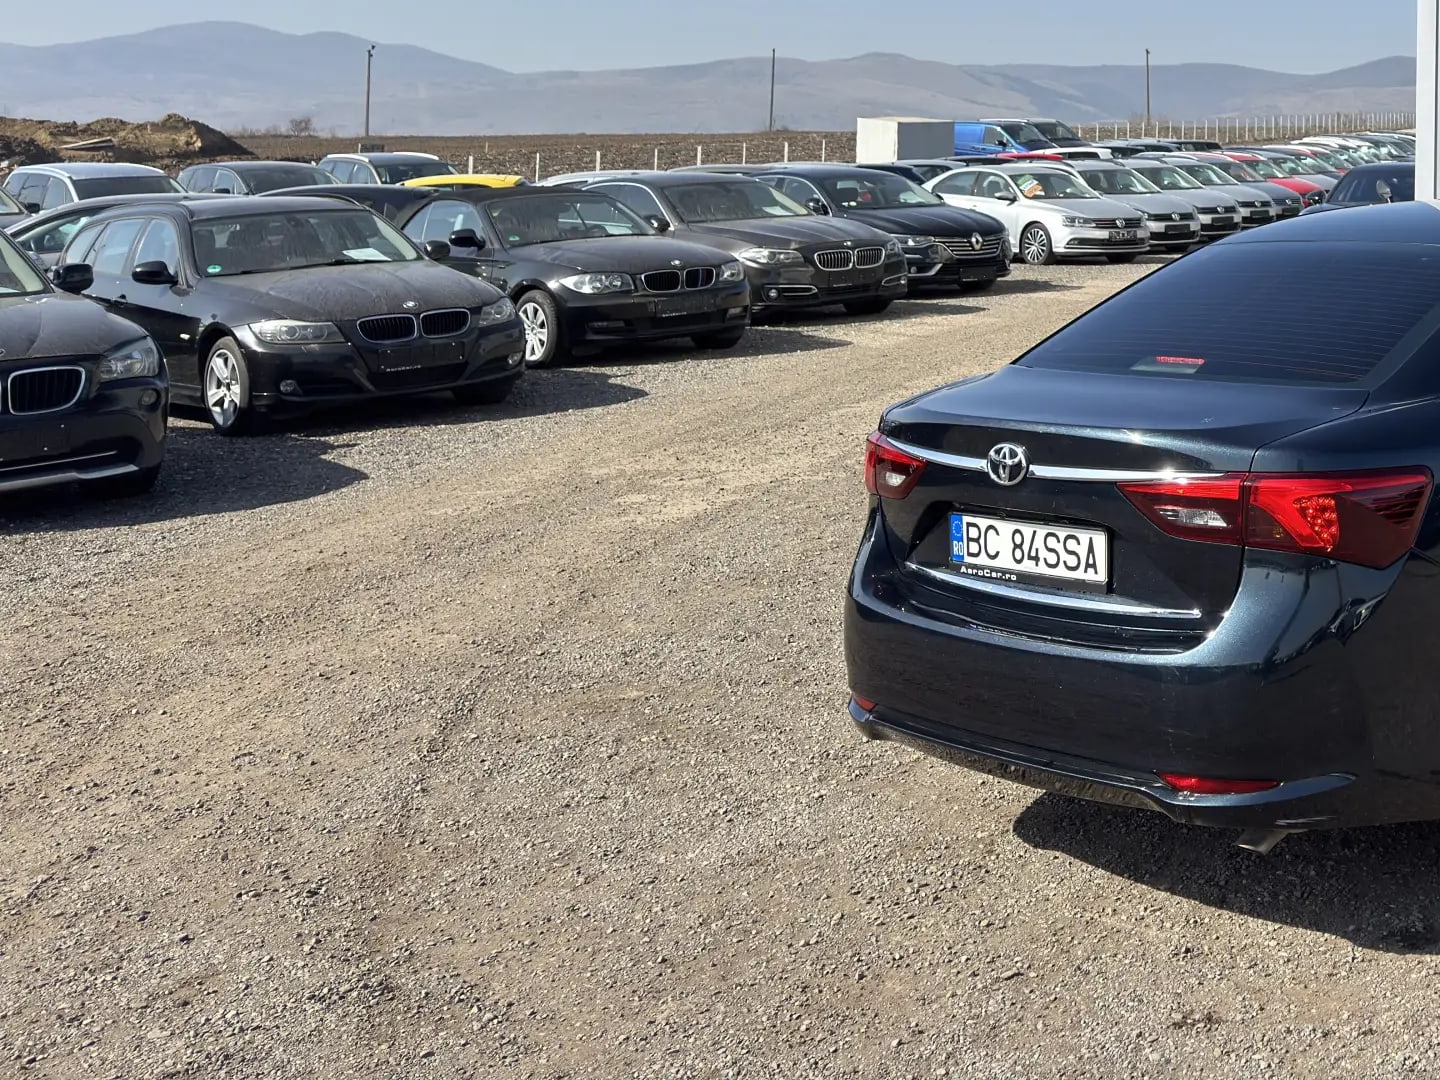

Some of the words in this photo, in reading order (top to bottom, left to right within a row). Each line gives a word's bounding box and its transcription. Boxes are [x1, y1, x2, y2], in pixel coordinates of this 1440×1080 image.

[953, 540, 964, 556] RO
[966, 522, 1000, 560] BC
[1011, 528, 1098, 575] 84SSA
[960, 566, 1017, 581] AeroCar.ro
